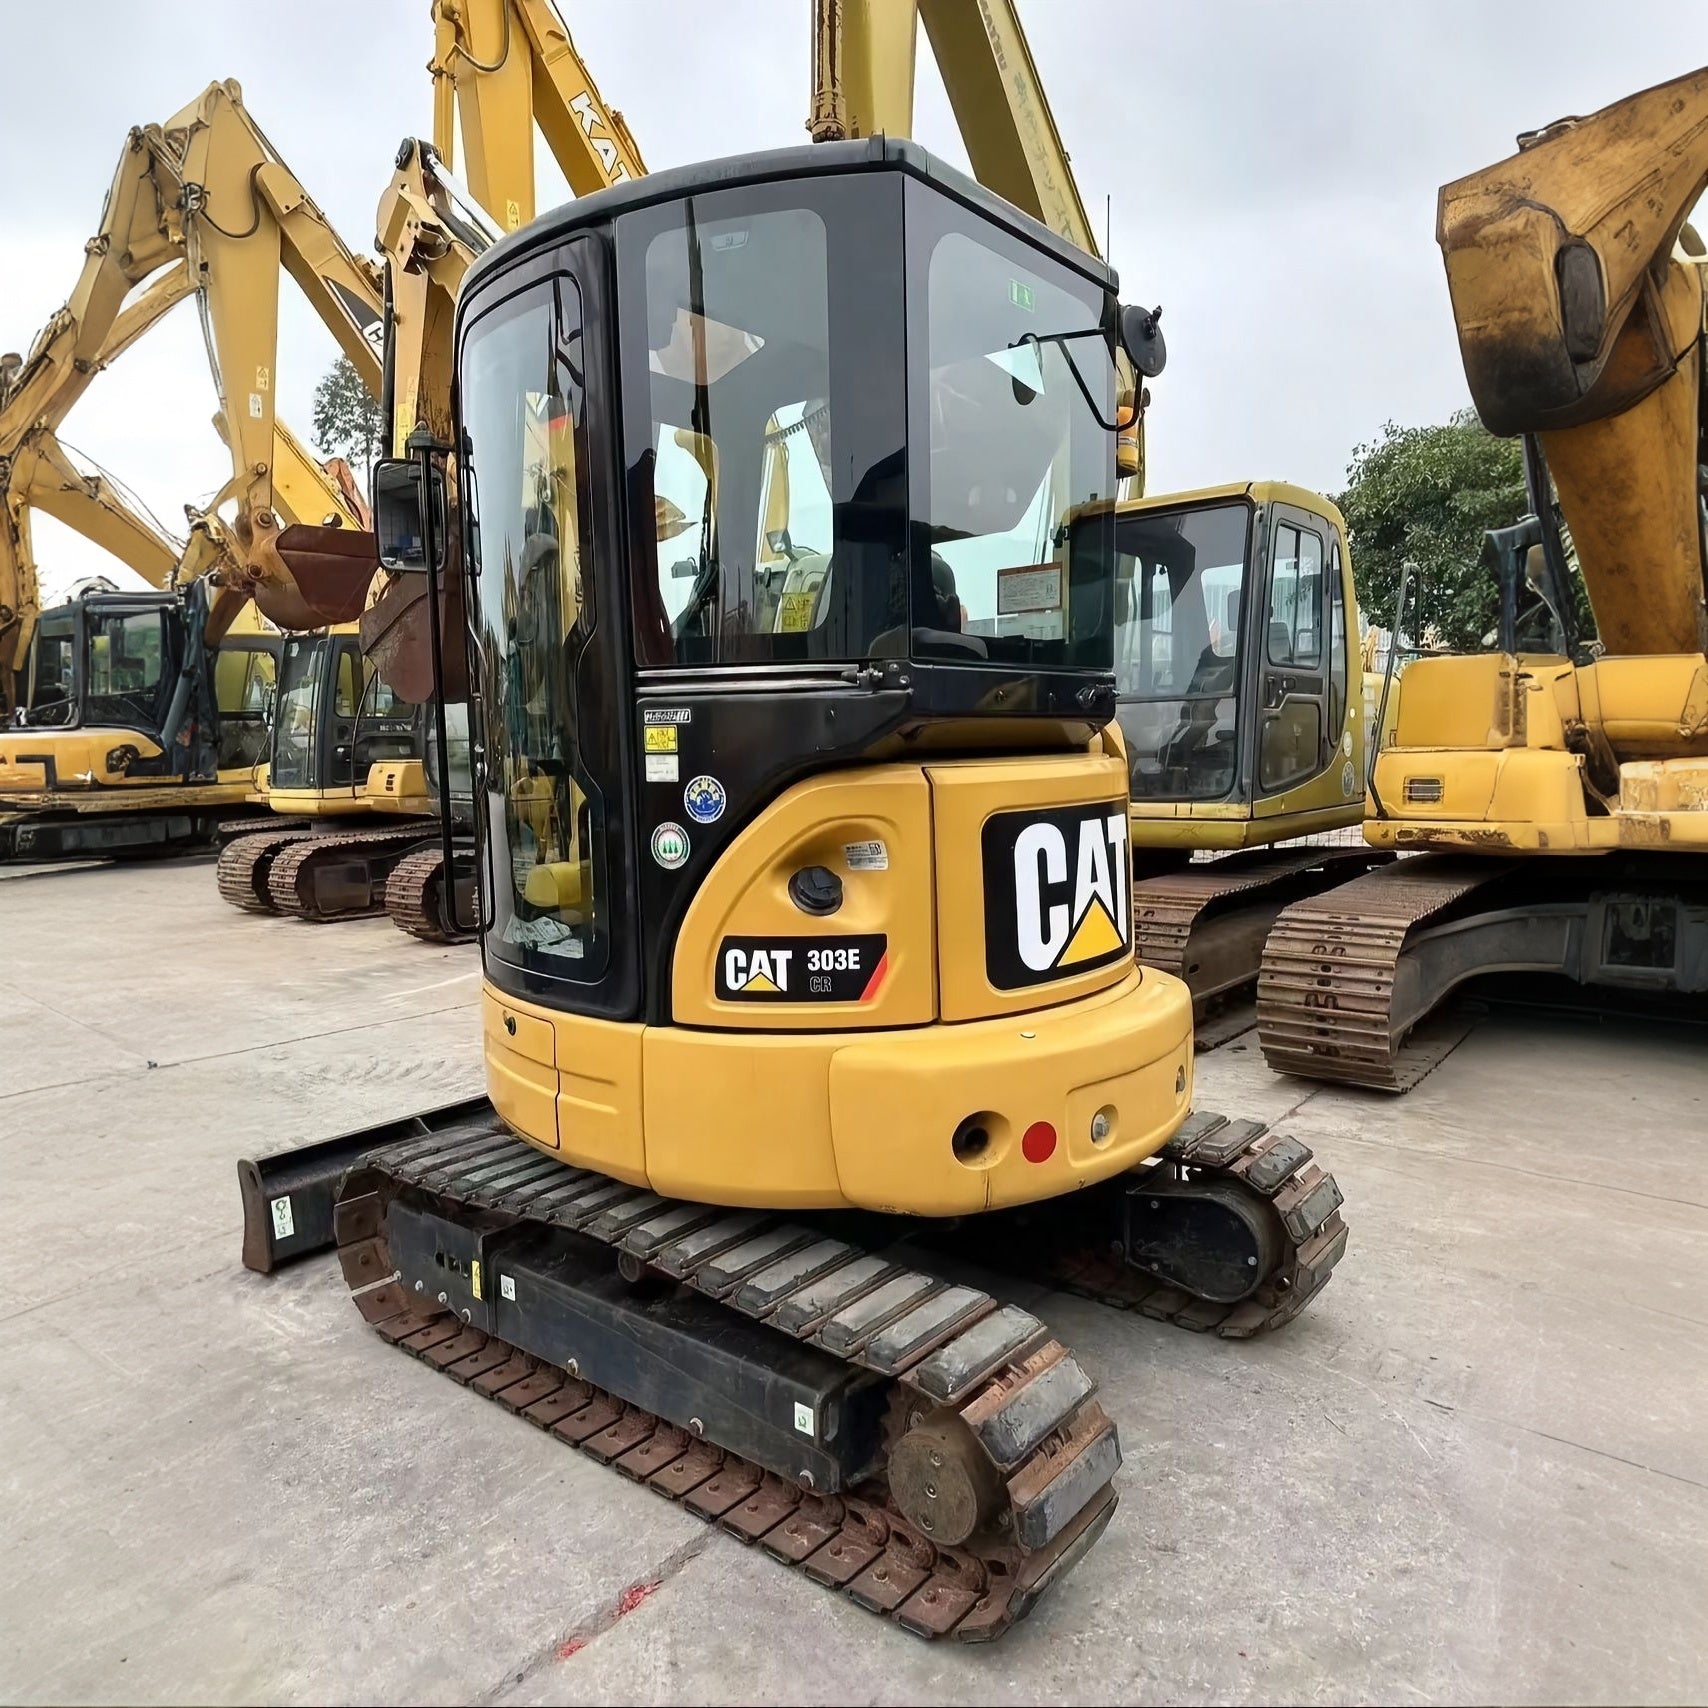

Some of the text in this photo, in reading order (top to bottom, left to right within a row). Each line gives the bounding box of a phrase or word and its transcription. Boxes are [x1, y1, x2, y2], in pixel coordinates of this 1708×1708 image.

[1014, 813, 1128, 971] CAT
[725, 948, 861, 992] CAT 303E
[809, 976, 832, 993] CR
